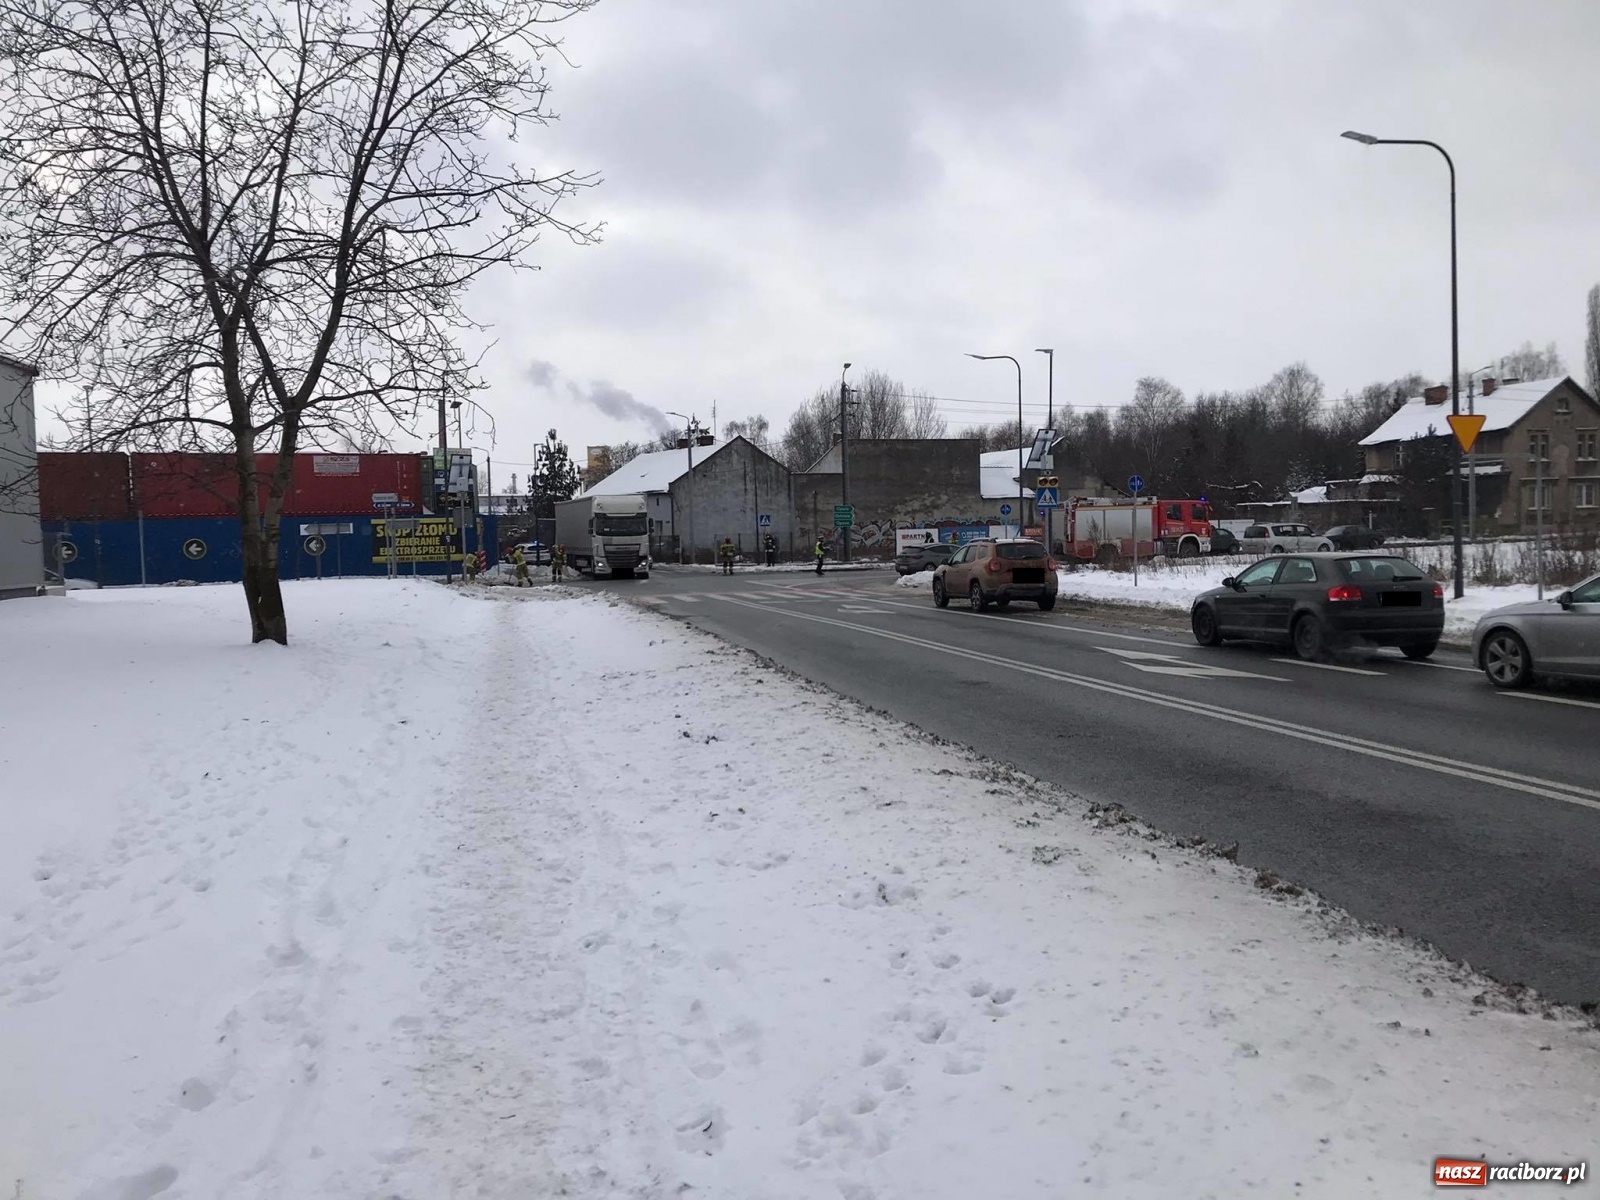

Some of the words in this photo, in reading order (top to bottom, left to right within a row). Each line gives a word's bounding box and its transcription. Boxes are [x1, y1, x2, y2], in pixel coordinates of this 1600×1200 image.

[376, 524, 411, 537] SUP
[395, 537, 441, 546] ZBIERANIE
[379, 545, 456, 555] EKTROSPRZĘTU
